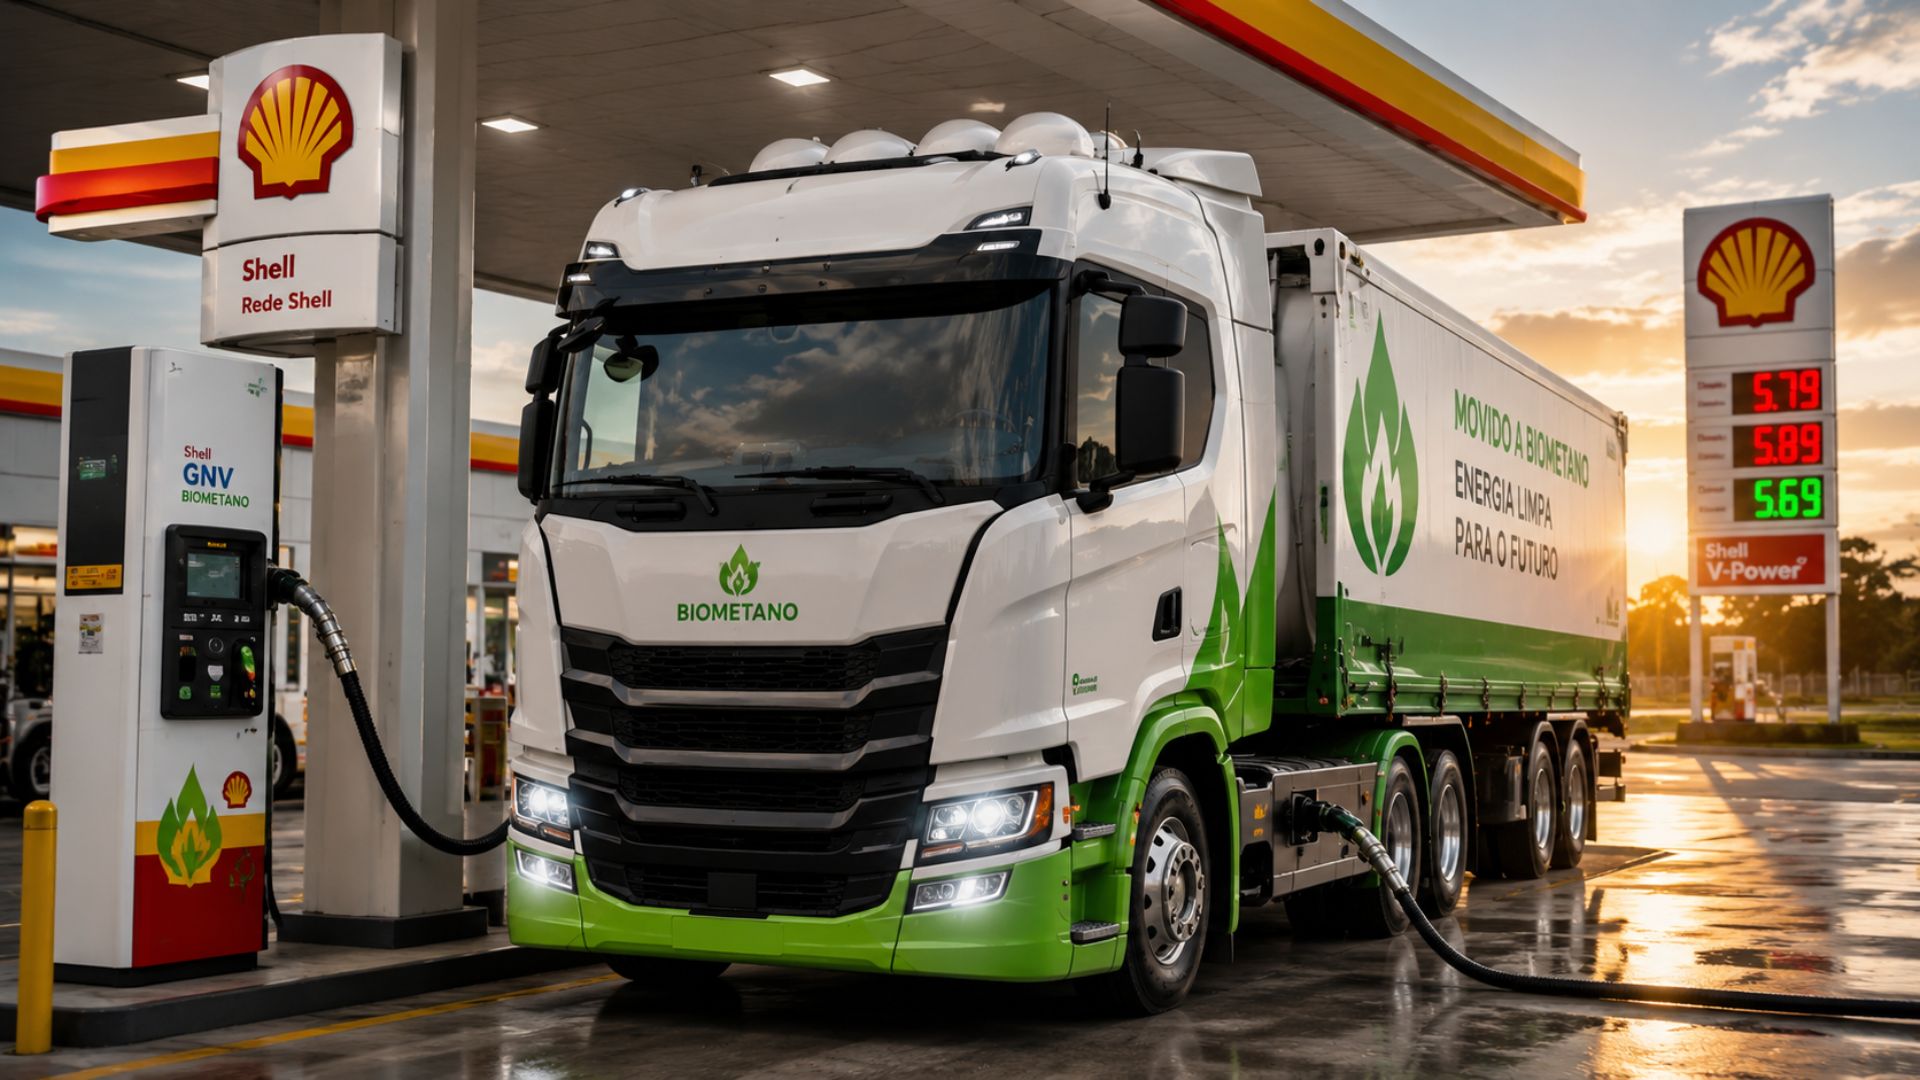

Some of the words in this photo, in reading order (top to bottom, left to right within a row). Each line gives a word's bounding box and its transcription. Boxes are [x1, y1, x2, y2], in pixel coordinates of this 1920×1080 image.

[242, 254, 295, 282] Shell
[242, 294, 283, 314] Rede
[288, 290, 332, 310] Shell
[1753, 369, 1820, 412] 5.79
[1454, 388, 1512, 453] MOVIDO
[1514, 421, 1524, 460] A
[1526, 425, 1590, 489] BIOMETANO
[1754, 423, 1821, 465] 5.89
[184, 445, 212, 460] Shell
[183, 462, 234, 489] GNV
[181, 489, 250, 508] BIOMETANO
[1455, 459, 1515, 517] ENERGIA
[1517, 486, 1553, 530] LIMPA
[1754, 477, 1821, 518] 5.69
[1455, 516, 1494, 564] PARA
[1496, 530, 1507, 568] O
[1510, 534, 1559, 580] FUTURO
[1705, 542, 1749, 559] Shell
[1706, 561, 1802, 581] V-Power
[677, 602, 799, 621] BIOMETANO
